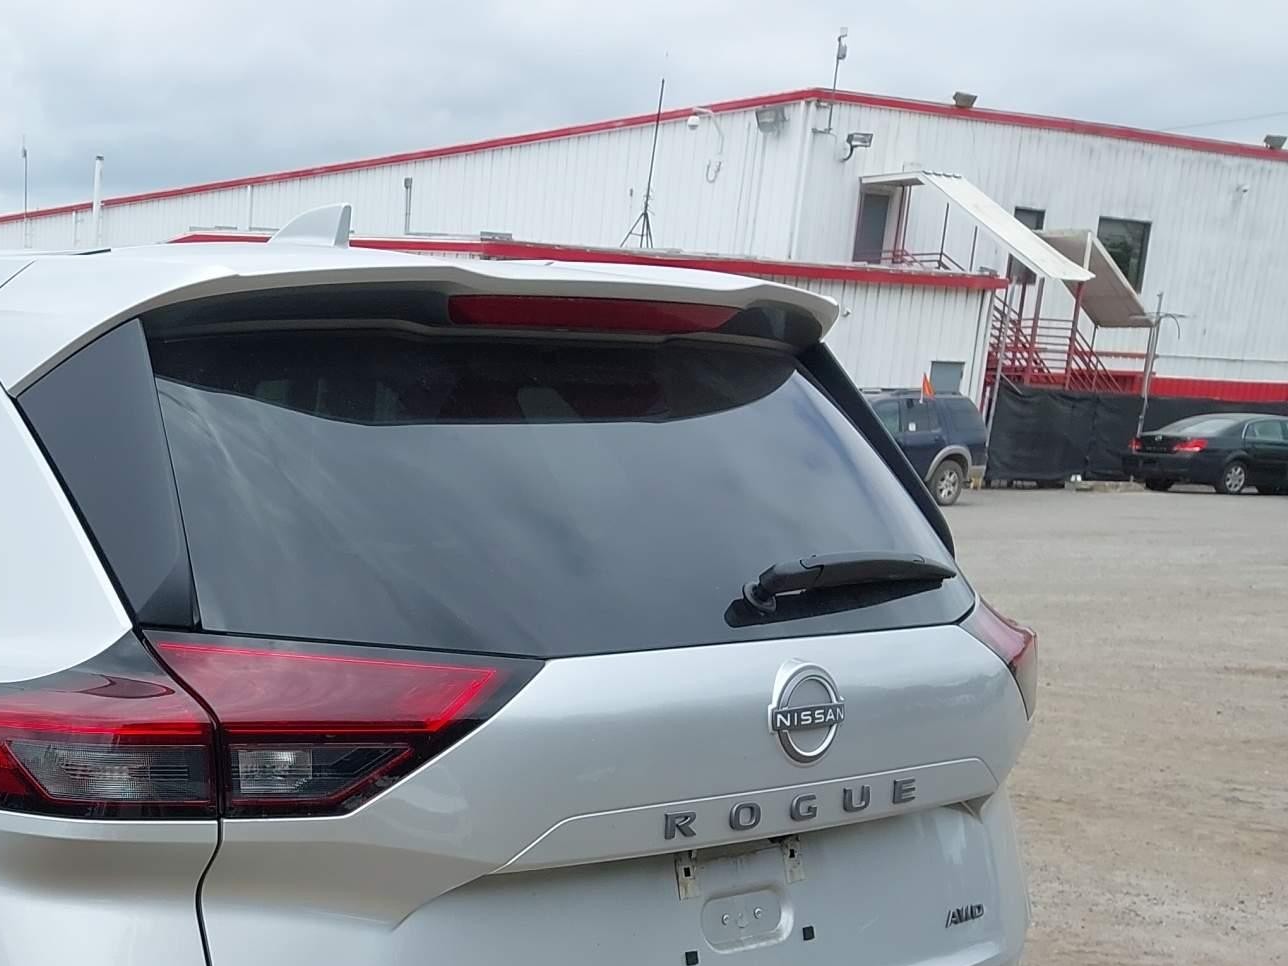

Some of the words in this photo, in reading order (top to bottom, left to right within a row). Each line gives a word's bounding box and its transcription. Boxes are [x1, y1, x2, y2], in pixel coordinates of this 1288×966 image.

[776, 706, 845, 728] NISSAN
[664, 778, 916, 840] ROGUE
[945, 903, 985, 928] AWD
